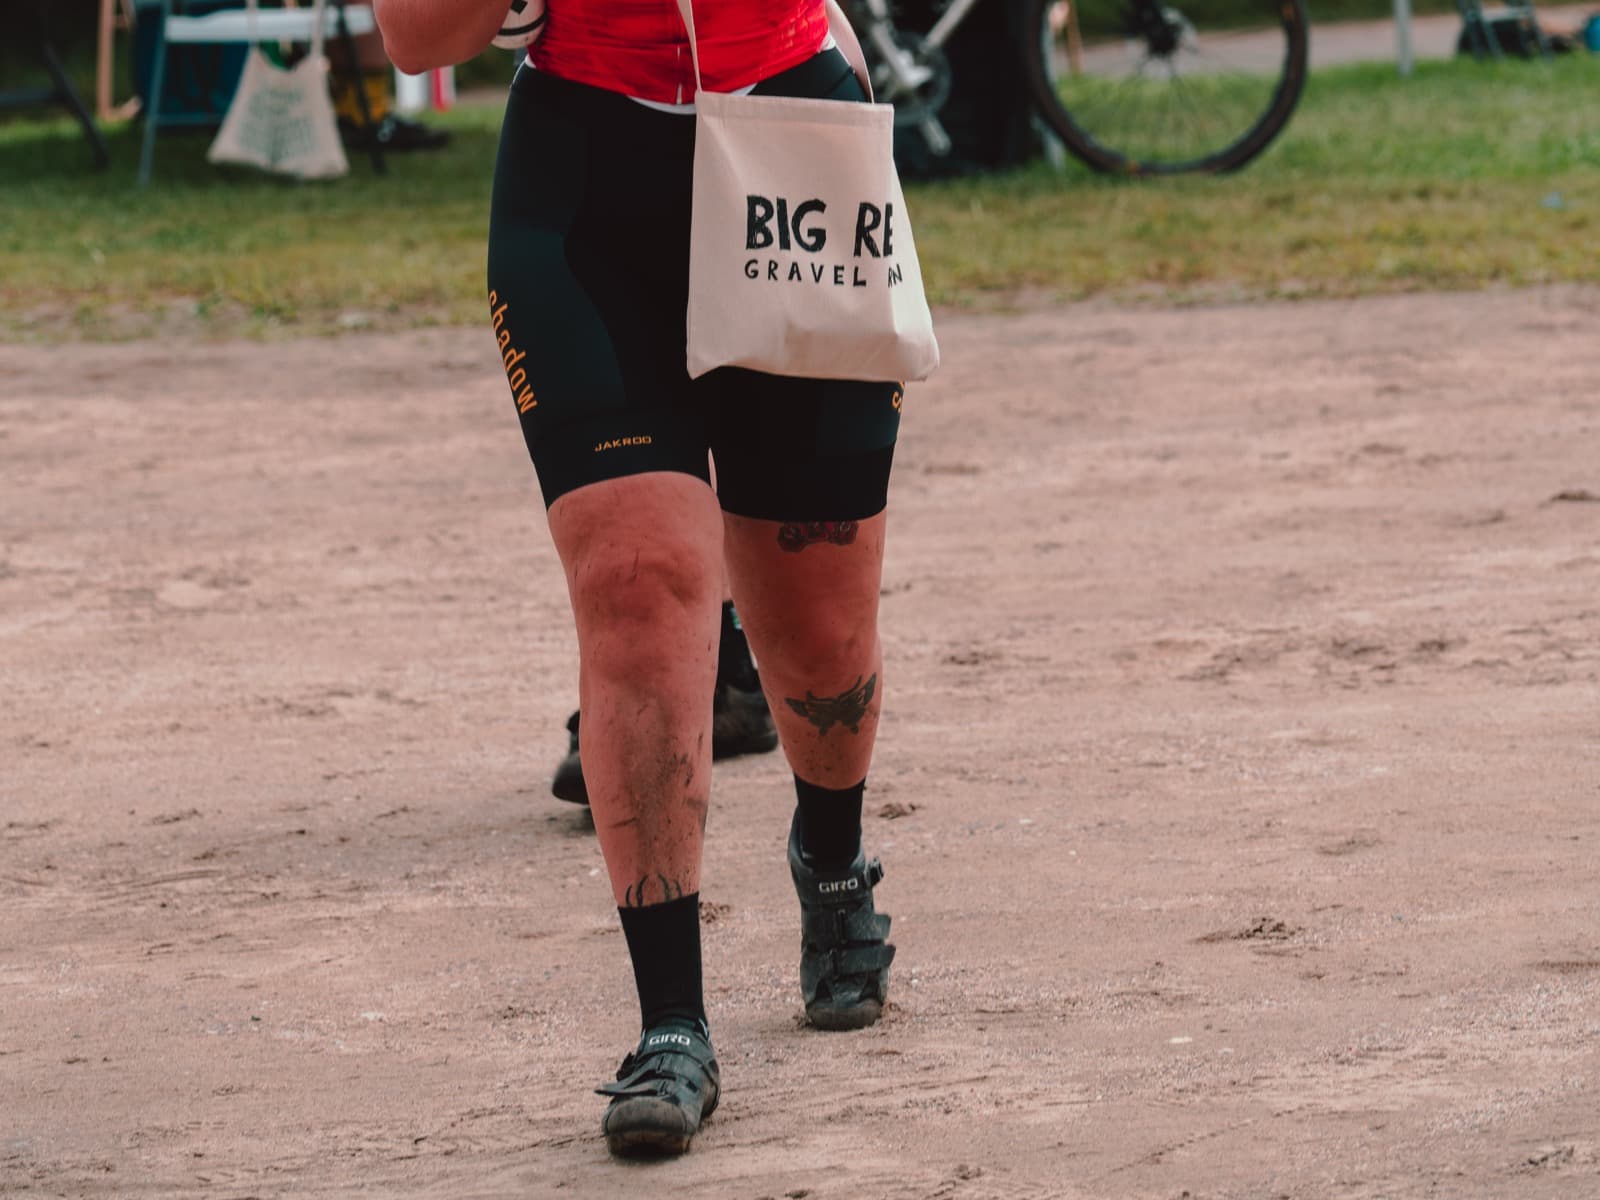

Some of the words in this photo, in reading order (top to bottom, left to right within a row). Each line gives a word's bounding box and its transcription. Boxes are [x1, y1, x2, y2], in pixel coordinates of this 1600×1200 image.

[745, 195, 827, 252] BIG
[853, 202, 893, 258] RE
[744, 259, 867, 287] GRAVEL
[594, 434, 652, 452] JAKROO
[818, 877, 858, 893] GIRO
[649, 1032, 691, 1046] GIRO
